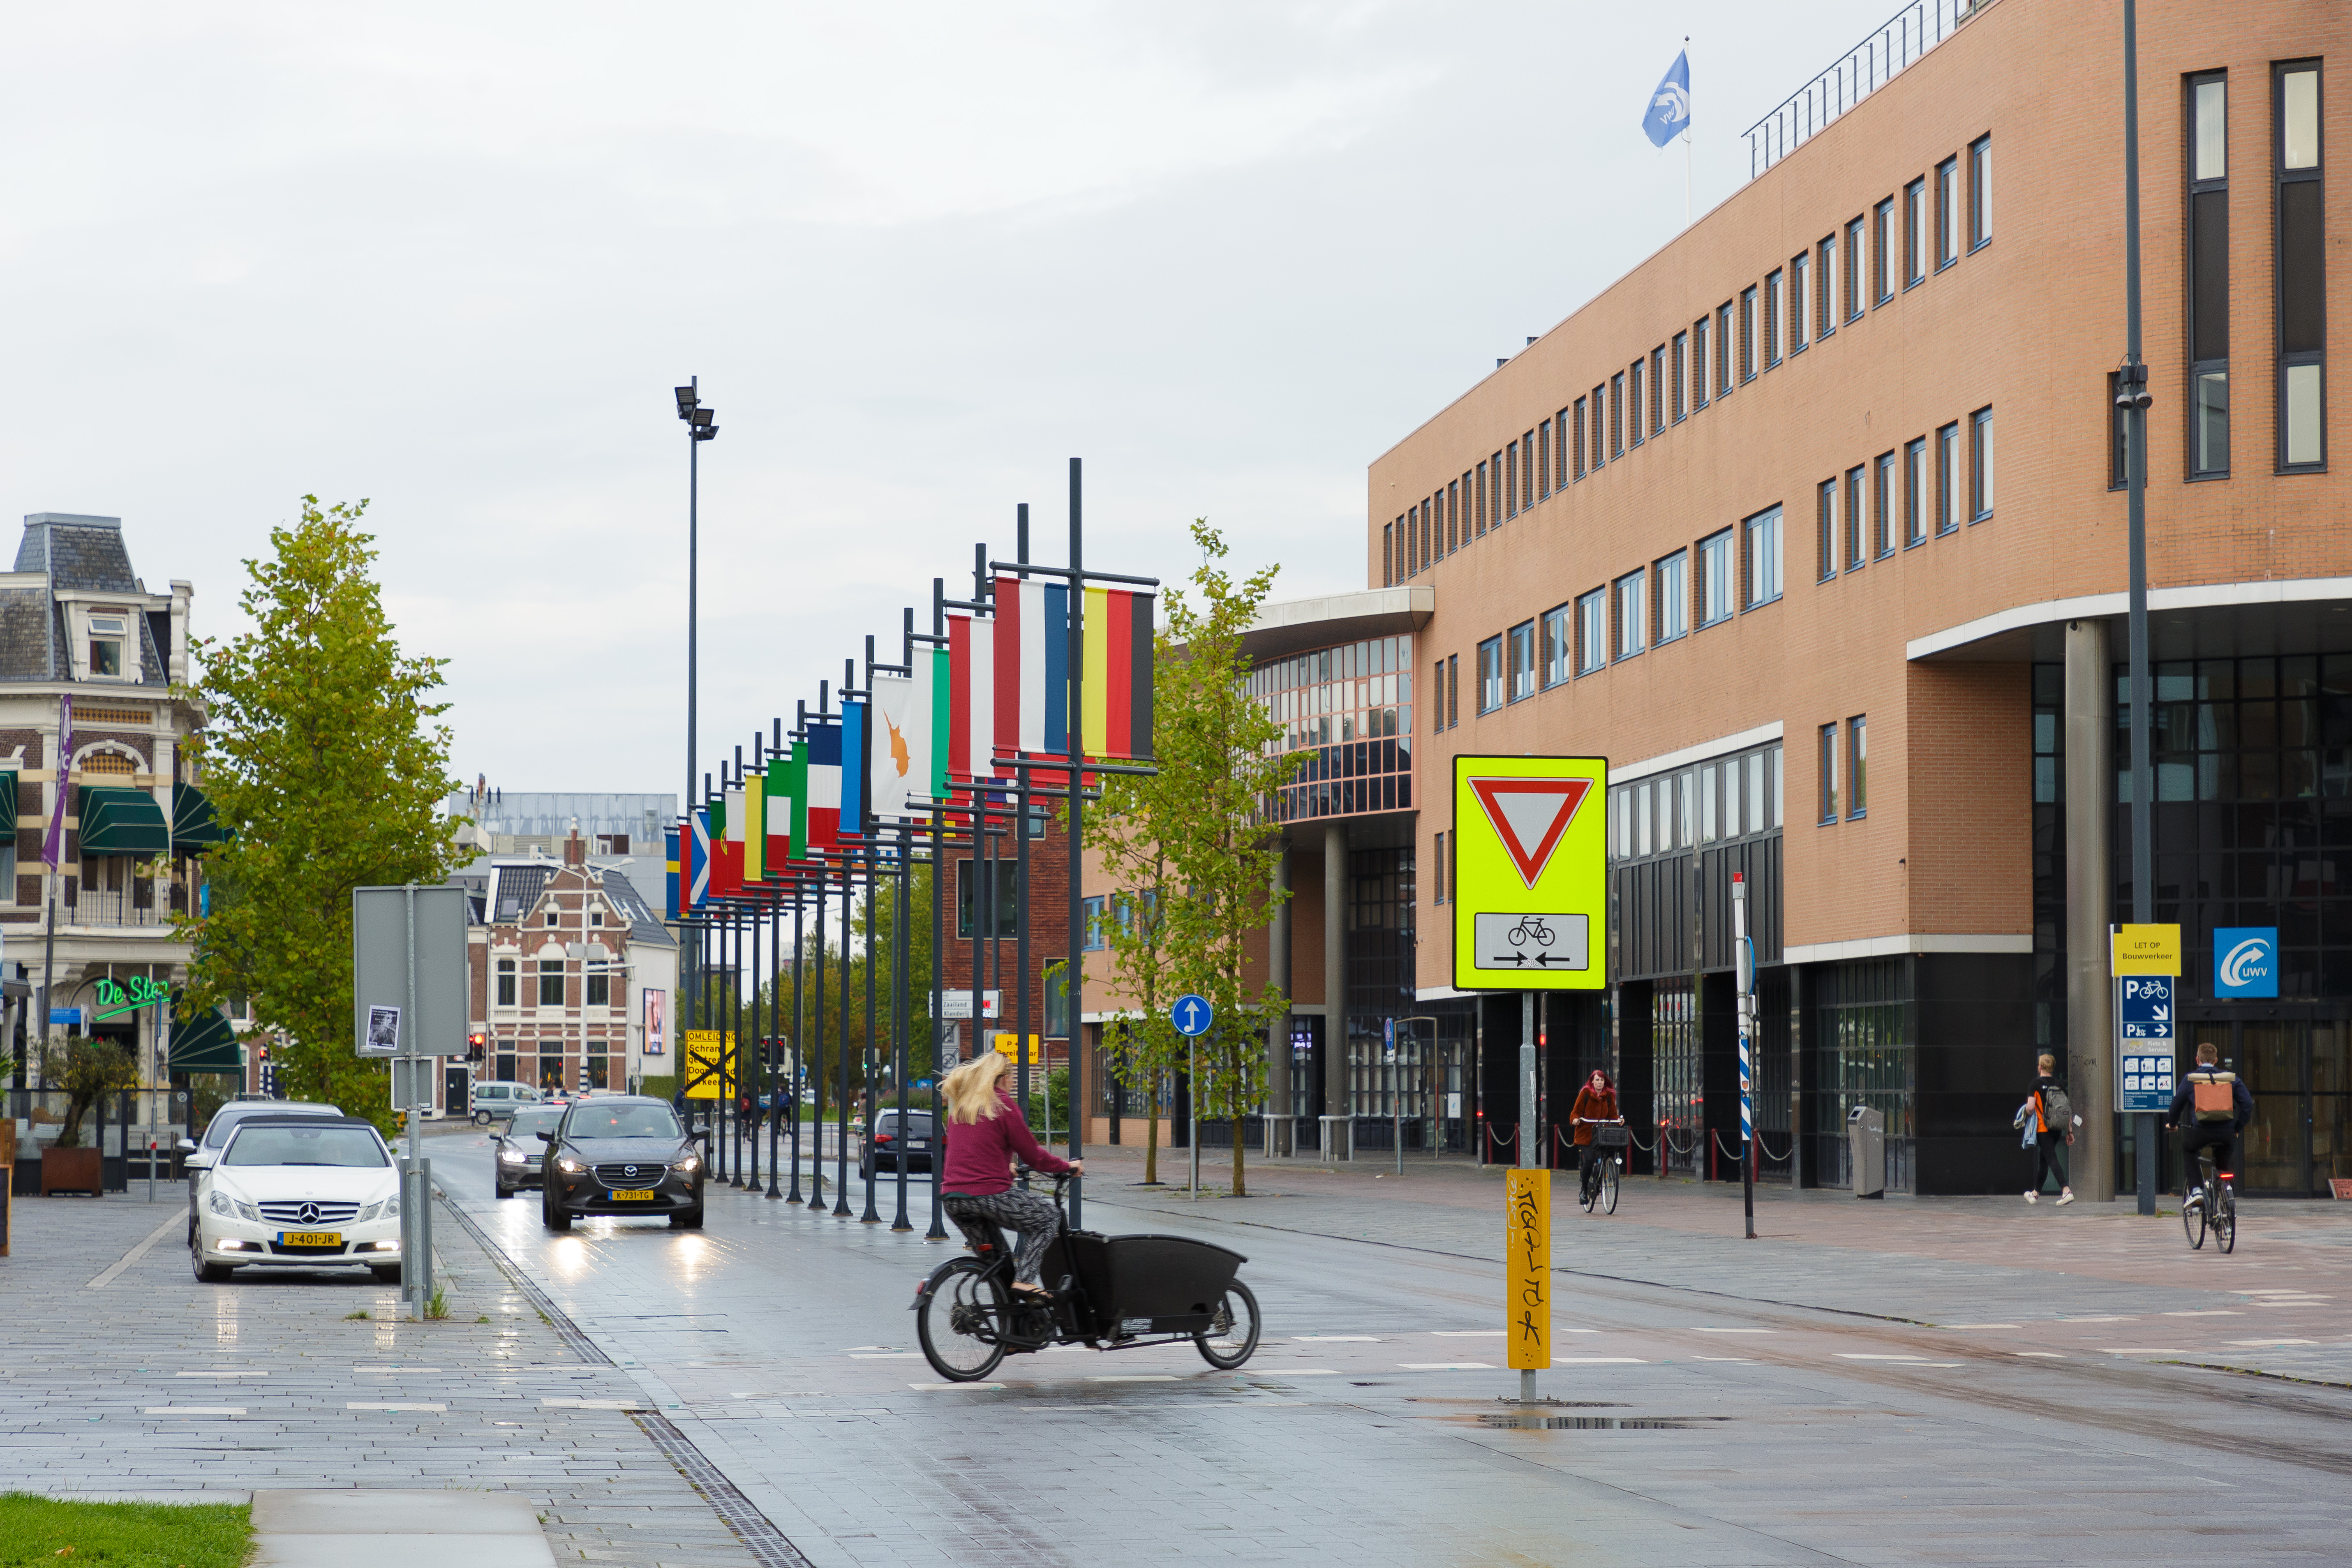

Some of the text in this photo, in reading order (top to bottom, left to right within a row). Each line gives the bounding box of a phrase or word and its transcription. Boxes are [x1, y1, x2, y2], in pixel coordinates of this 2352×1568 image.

[96, 979, 124, 1005] De
[2126, 980, 2139, 999] P
[689, 1032, 735, 1041] OMLEIDNG
[2127, 1024, 2136, 1037] P
[289, 1234, 334, 1244] J-401-JR
